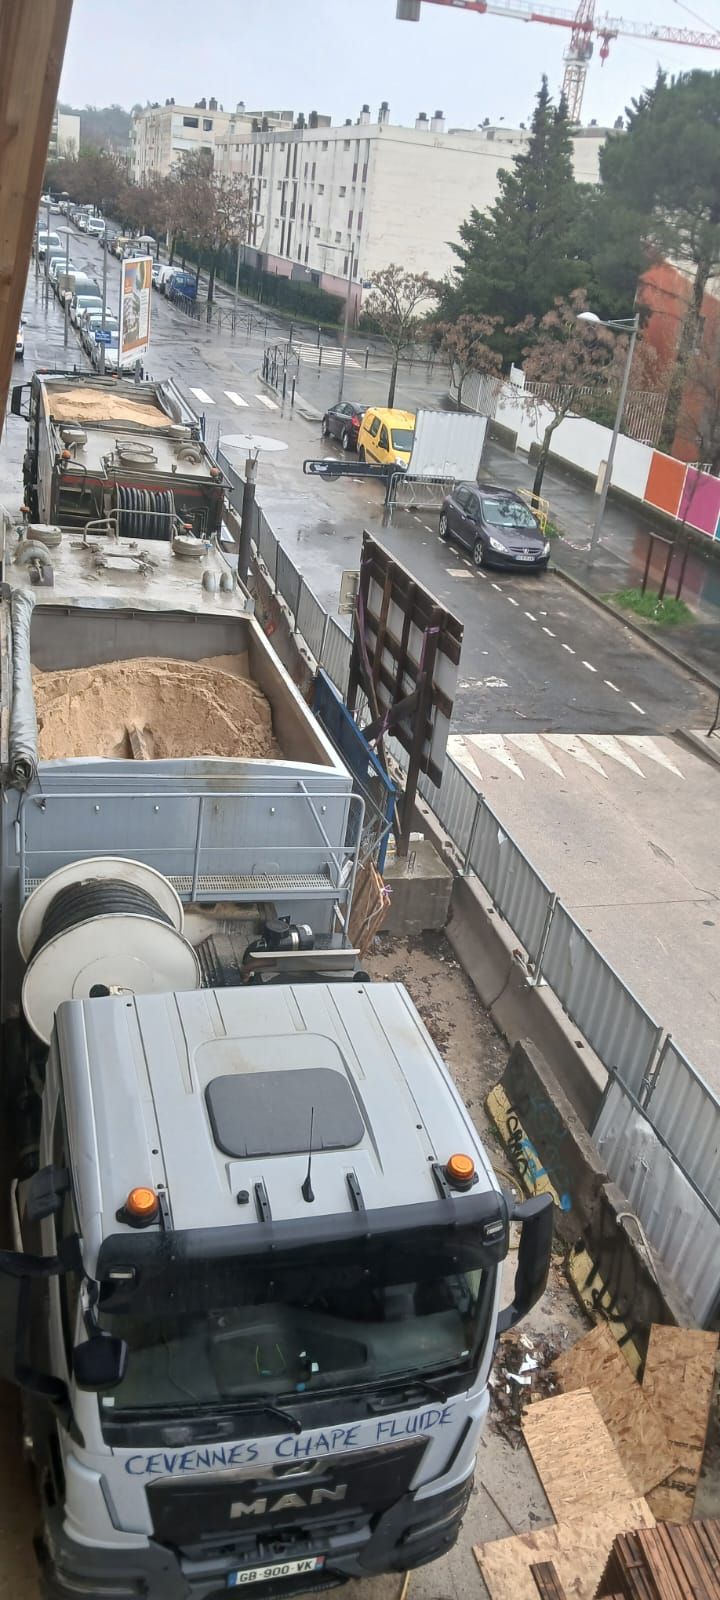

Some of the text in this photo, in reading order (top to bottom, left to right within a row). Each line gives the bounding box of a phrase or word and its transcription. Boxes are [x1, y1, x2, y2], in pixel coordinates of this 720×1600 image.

[124, 1403, 456, 1475] CEVENNES CHAPE FLUIDE
[230, 1484, 348, 1519] MAN
[240, 1561, 313, 1582] GB-900-VK
